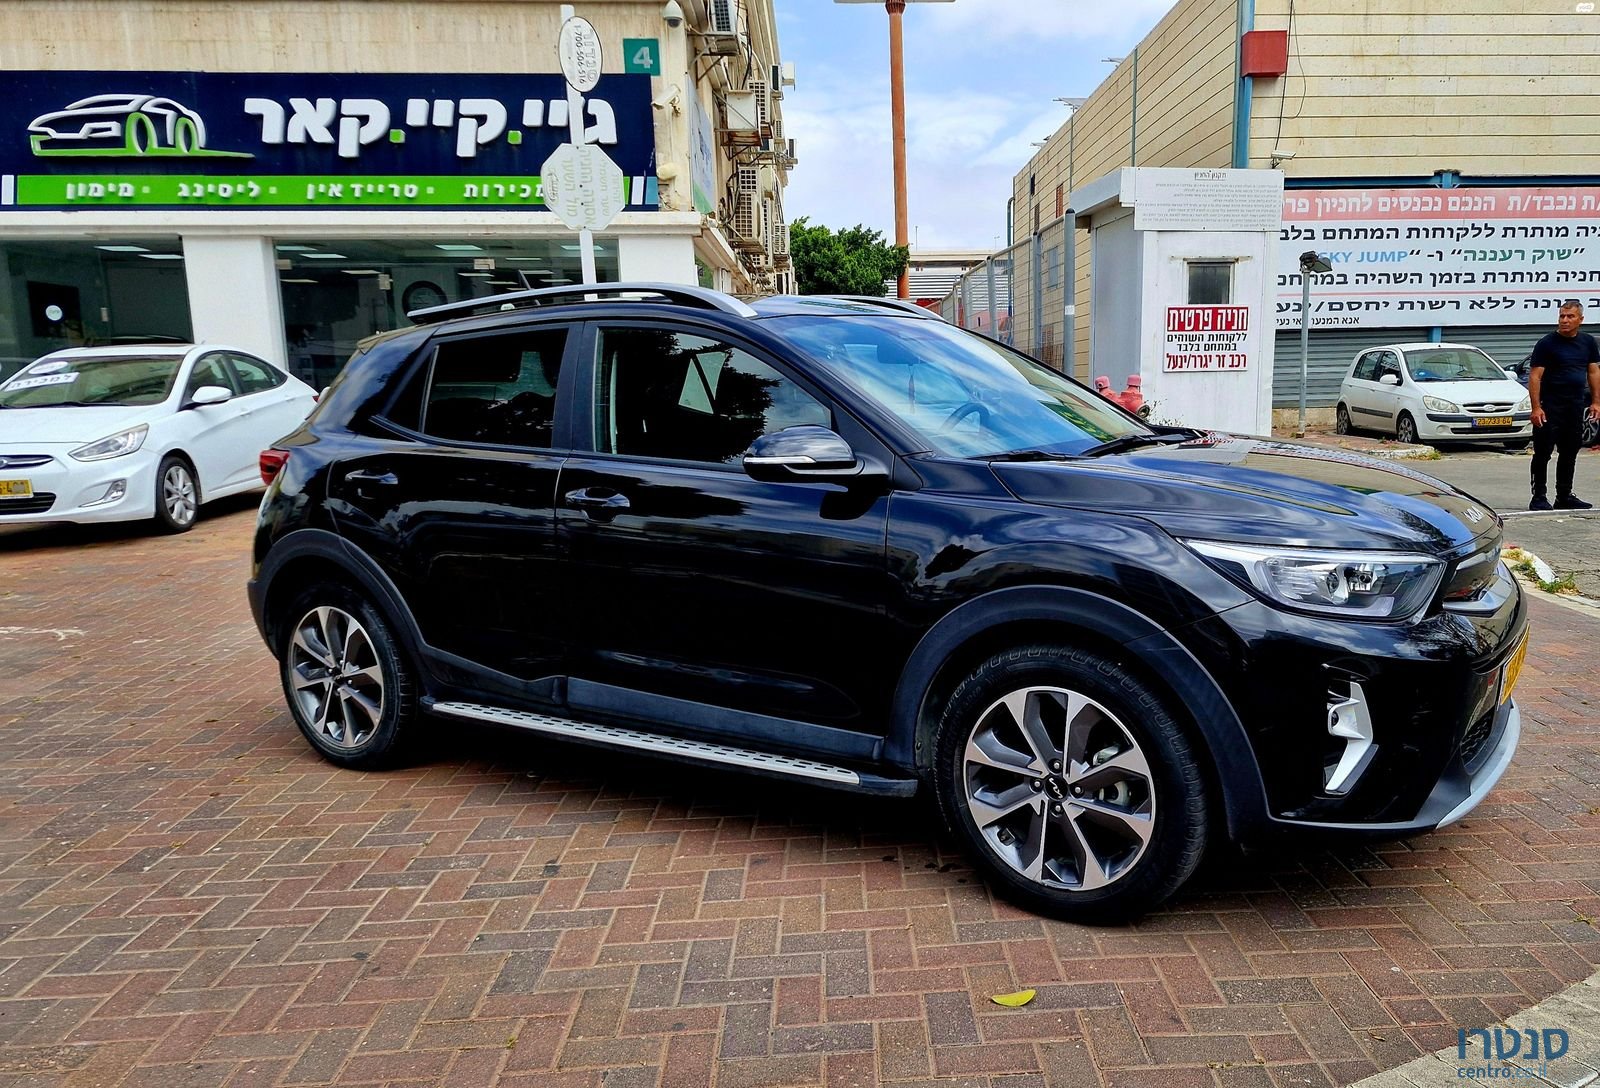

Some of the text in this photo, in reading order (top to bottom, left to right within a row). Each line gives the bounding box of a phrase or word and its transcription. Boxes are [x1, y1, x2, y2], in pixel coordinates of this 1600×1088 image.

[632, 46, 653, 69] 4
[244, 97, 618, 158] גיי.קיי.קאר
[65, 183, 135, 200] מימון
[177, 180, 261, 198] ליסינג
[306, 183, 344, 200] אין
[351, 183, 419, 198] טרייד
[566, 197, 580, 217] מול
[583, 189, 597, 225] אסורה
[1283, 197, 1310, 213] פר
[1315, 191, 1373, 217] לחניון
[1377, 195, 1442, 212] נכנסים
[1447, 195, 1496, 212] הנכם
[1507, 194, 1577, 212] נכבד/ת
[1322, 227, 1400, 240] המתחם
[1405, 222, 1496, 242] ללקוחות
[1501, 225, 1570, 238] מותרת
[1355, 271, 1423, 285] השהיה
[1430, 271, 1476, 287] בזמן
[1481, 270, 1549, 284] מותרת
[1398, 299, 1461, 310] רשות
[1469, 297, 1516, 310] ללא
[1524, 298, 1580, 309] ונה
[1168, 308, 1248, 331] חניה פרטית
[1311, 317, 1340, 326] המנעו
[1341, 316, 1360, 325] אנא
[1167, 332, 1247, 343] ללקוחות השוהים
[1177, 342, 1237, 351] במתחם בלבד
[1166, 353, 1247, 369] רכב זר יגרר/ינעל
